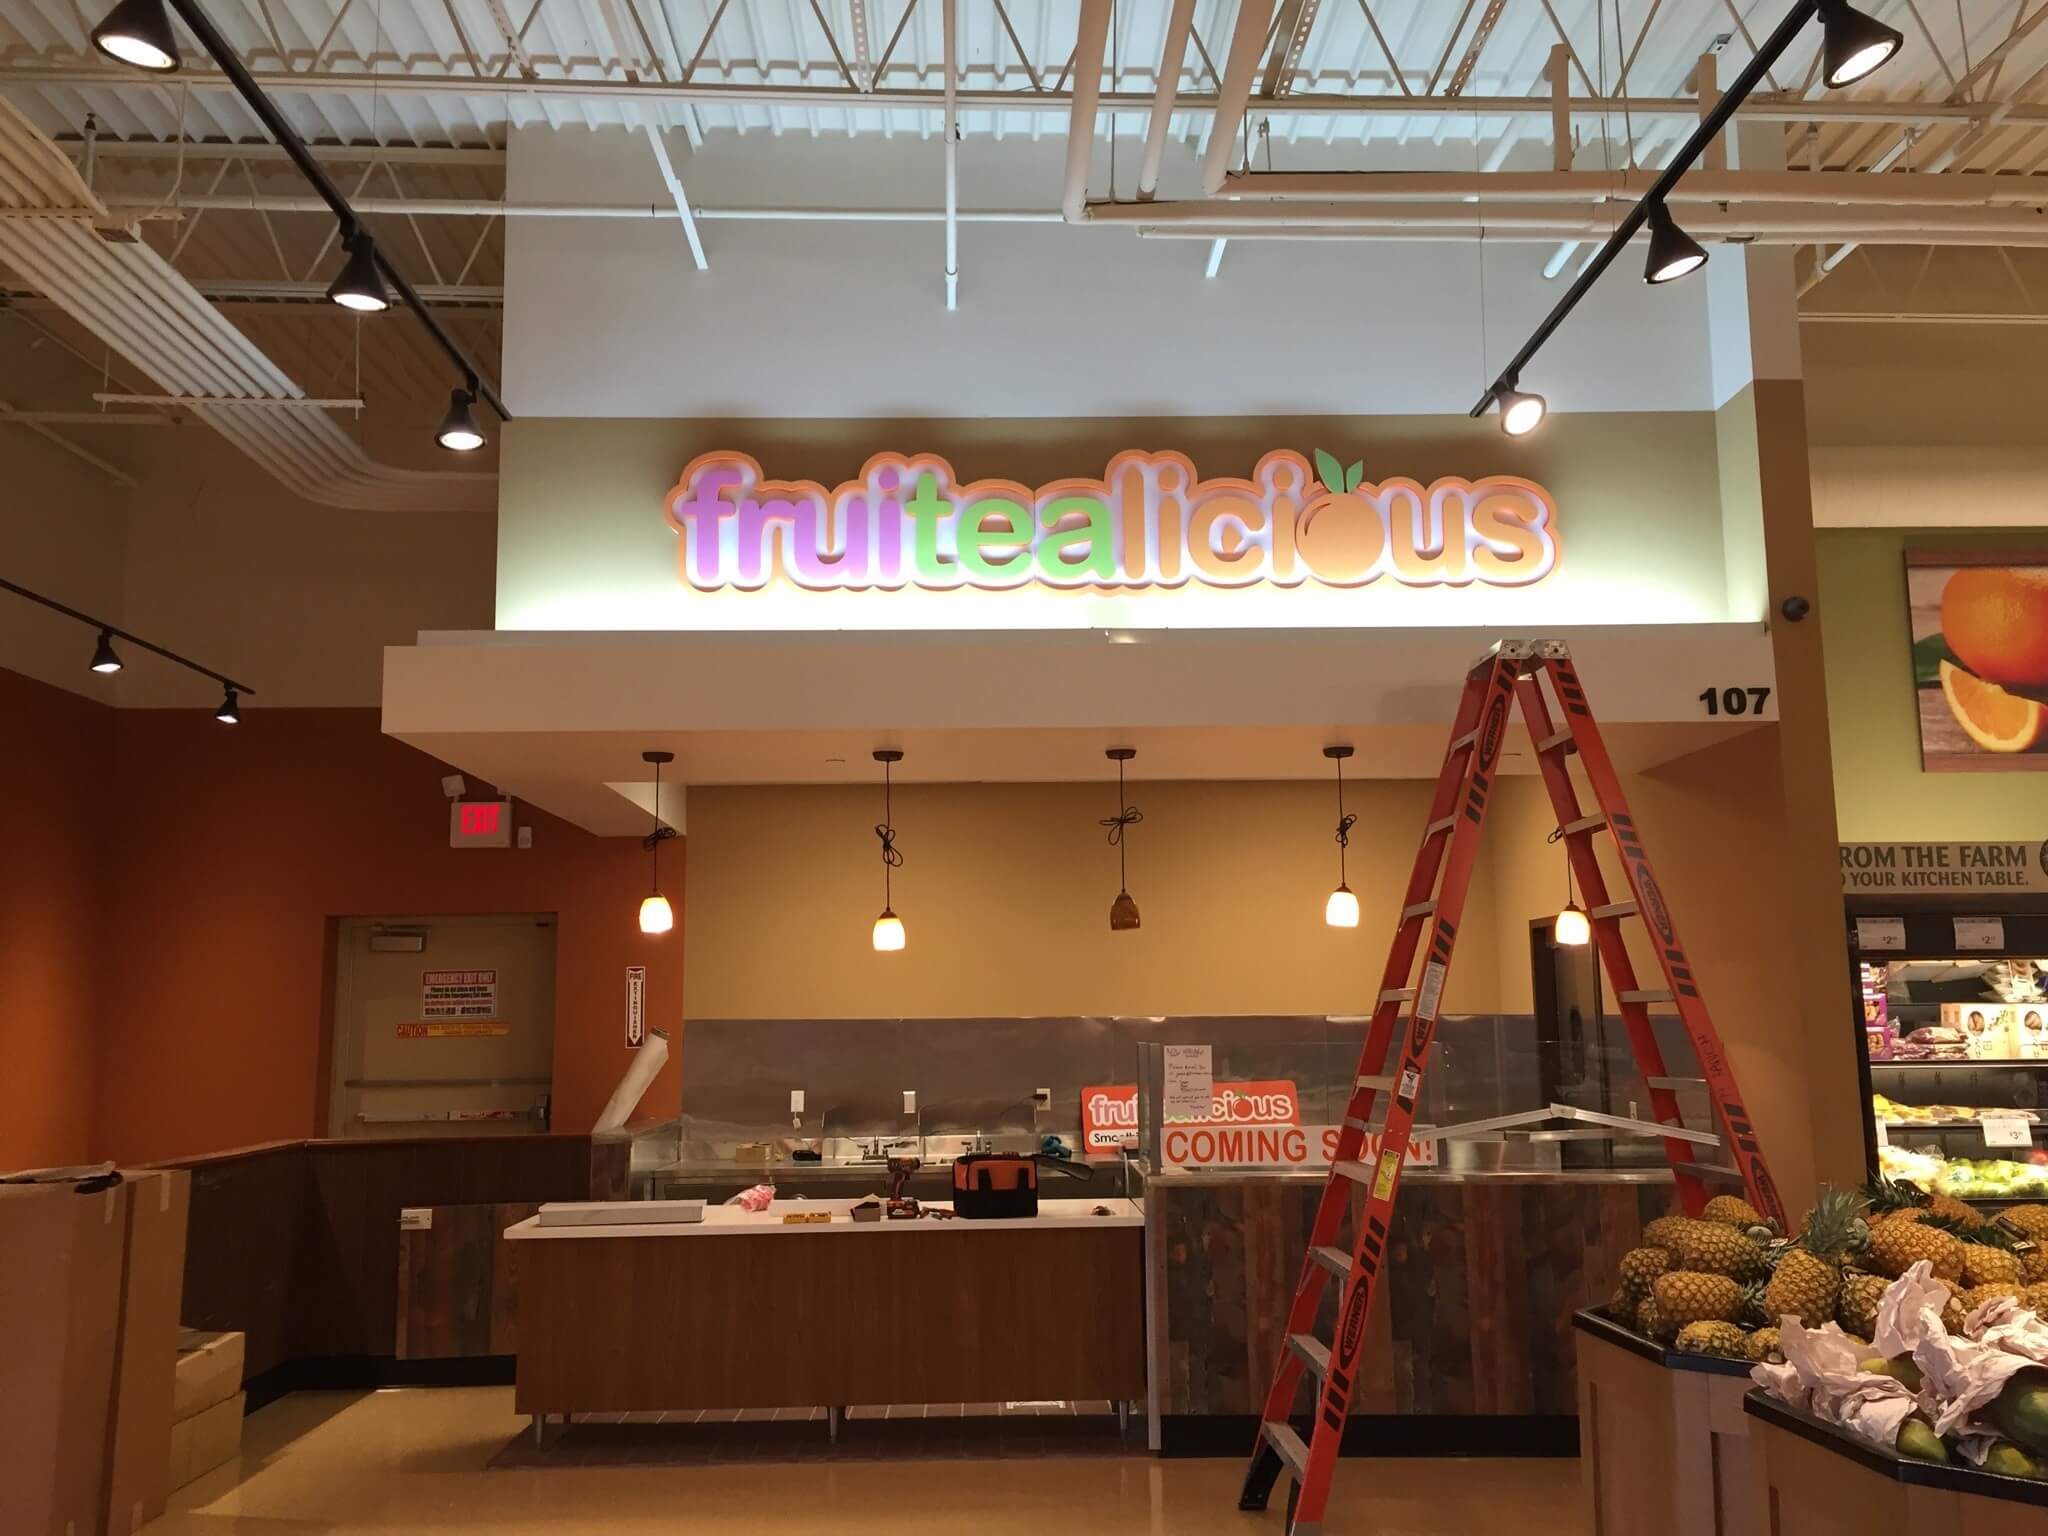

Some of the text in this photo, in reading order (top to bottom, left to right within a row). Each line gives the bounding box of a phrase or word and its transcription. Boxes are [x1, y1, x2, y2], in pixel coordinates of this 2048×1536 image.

[681, 462, 1549, 584] fruitealicious
[1699, 687, 1771, 715] 107
[462, 804, 500, 833] EXIT
[1840, 845, 2027, 868] ROM THE FARM
[1850, 872, 1896, 886] YOUR
[1903, 871, 1972, 886] KITCHEN
[1976, 871, 2029, 886] TABLE.
[1166, 1129, 1307, 1163] COMING
[1344, 1291, 1364, 1349] WERNER
